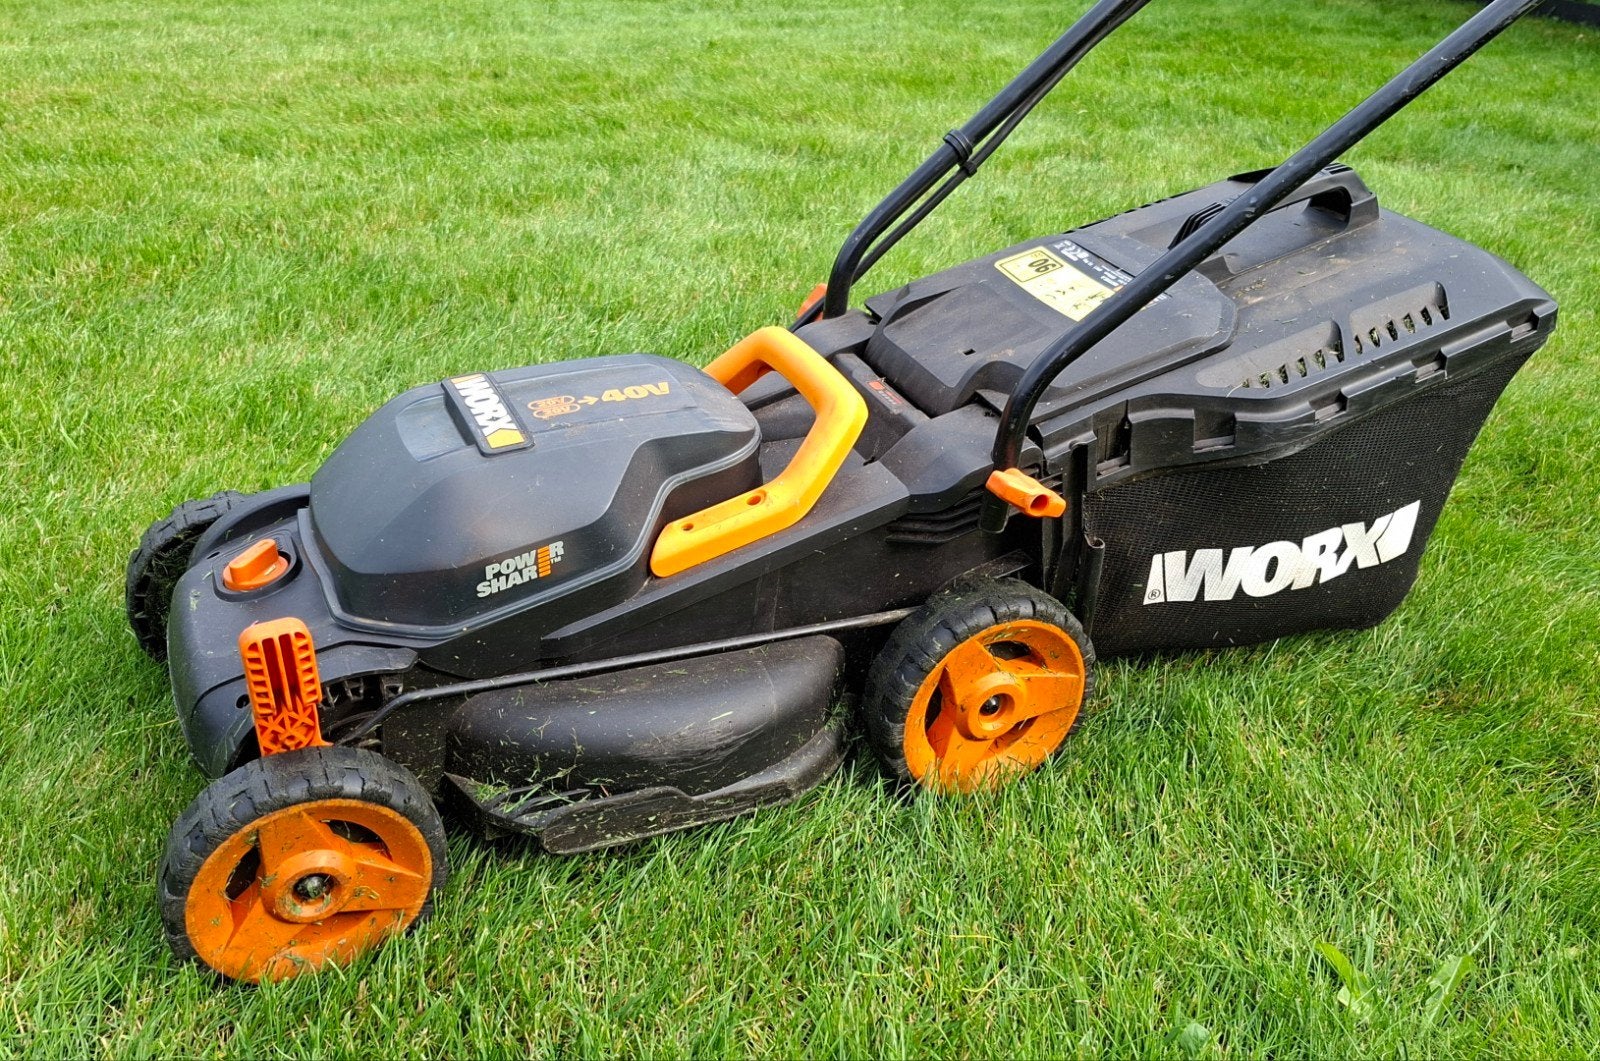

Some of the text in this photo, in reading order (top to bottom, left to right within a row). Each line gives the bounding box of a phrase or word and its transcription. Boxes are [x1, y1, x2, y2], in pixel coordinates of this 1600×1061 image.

[453, 376, 519, 437] WORX
[601, 381, 671, 402] 40V
[1158, 508, 1400, 603] WORX
